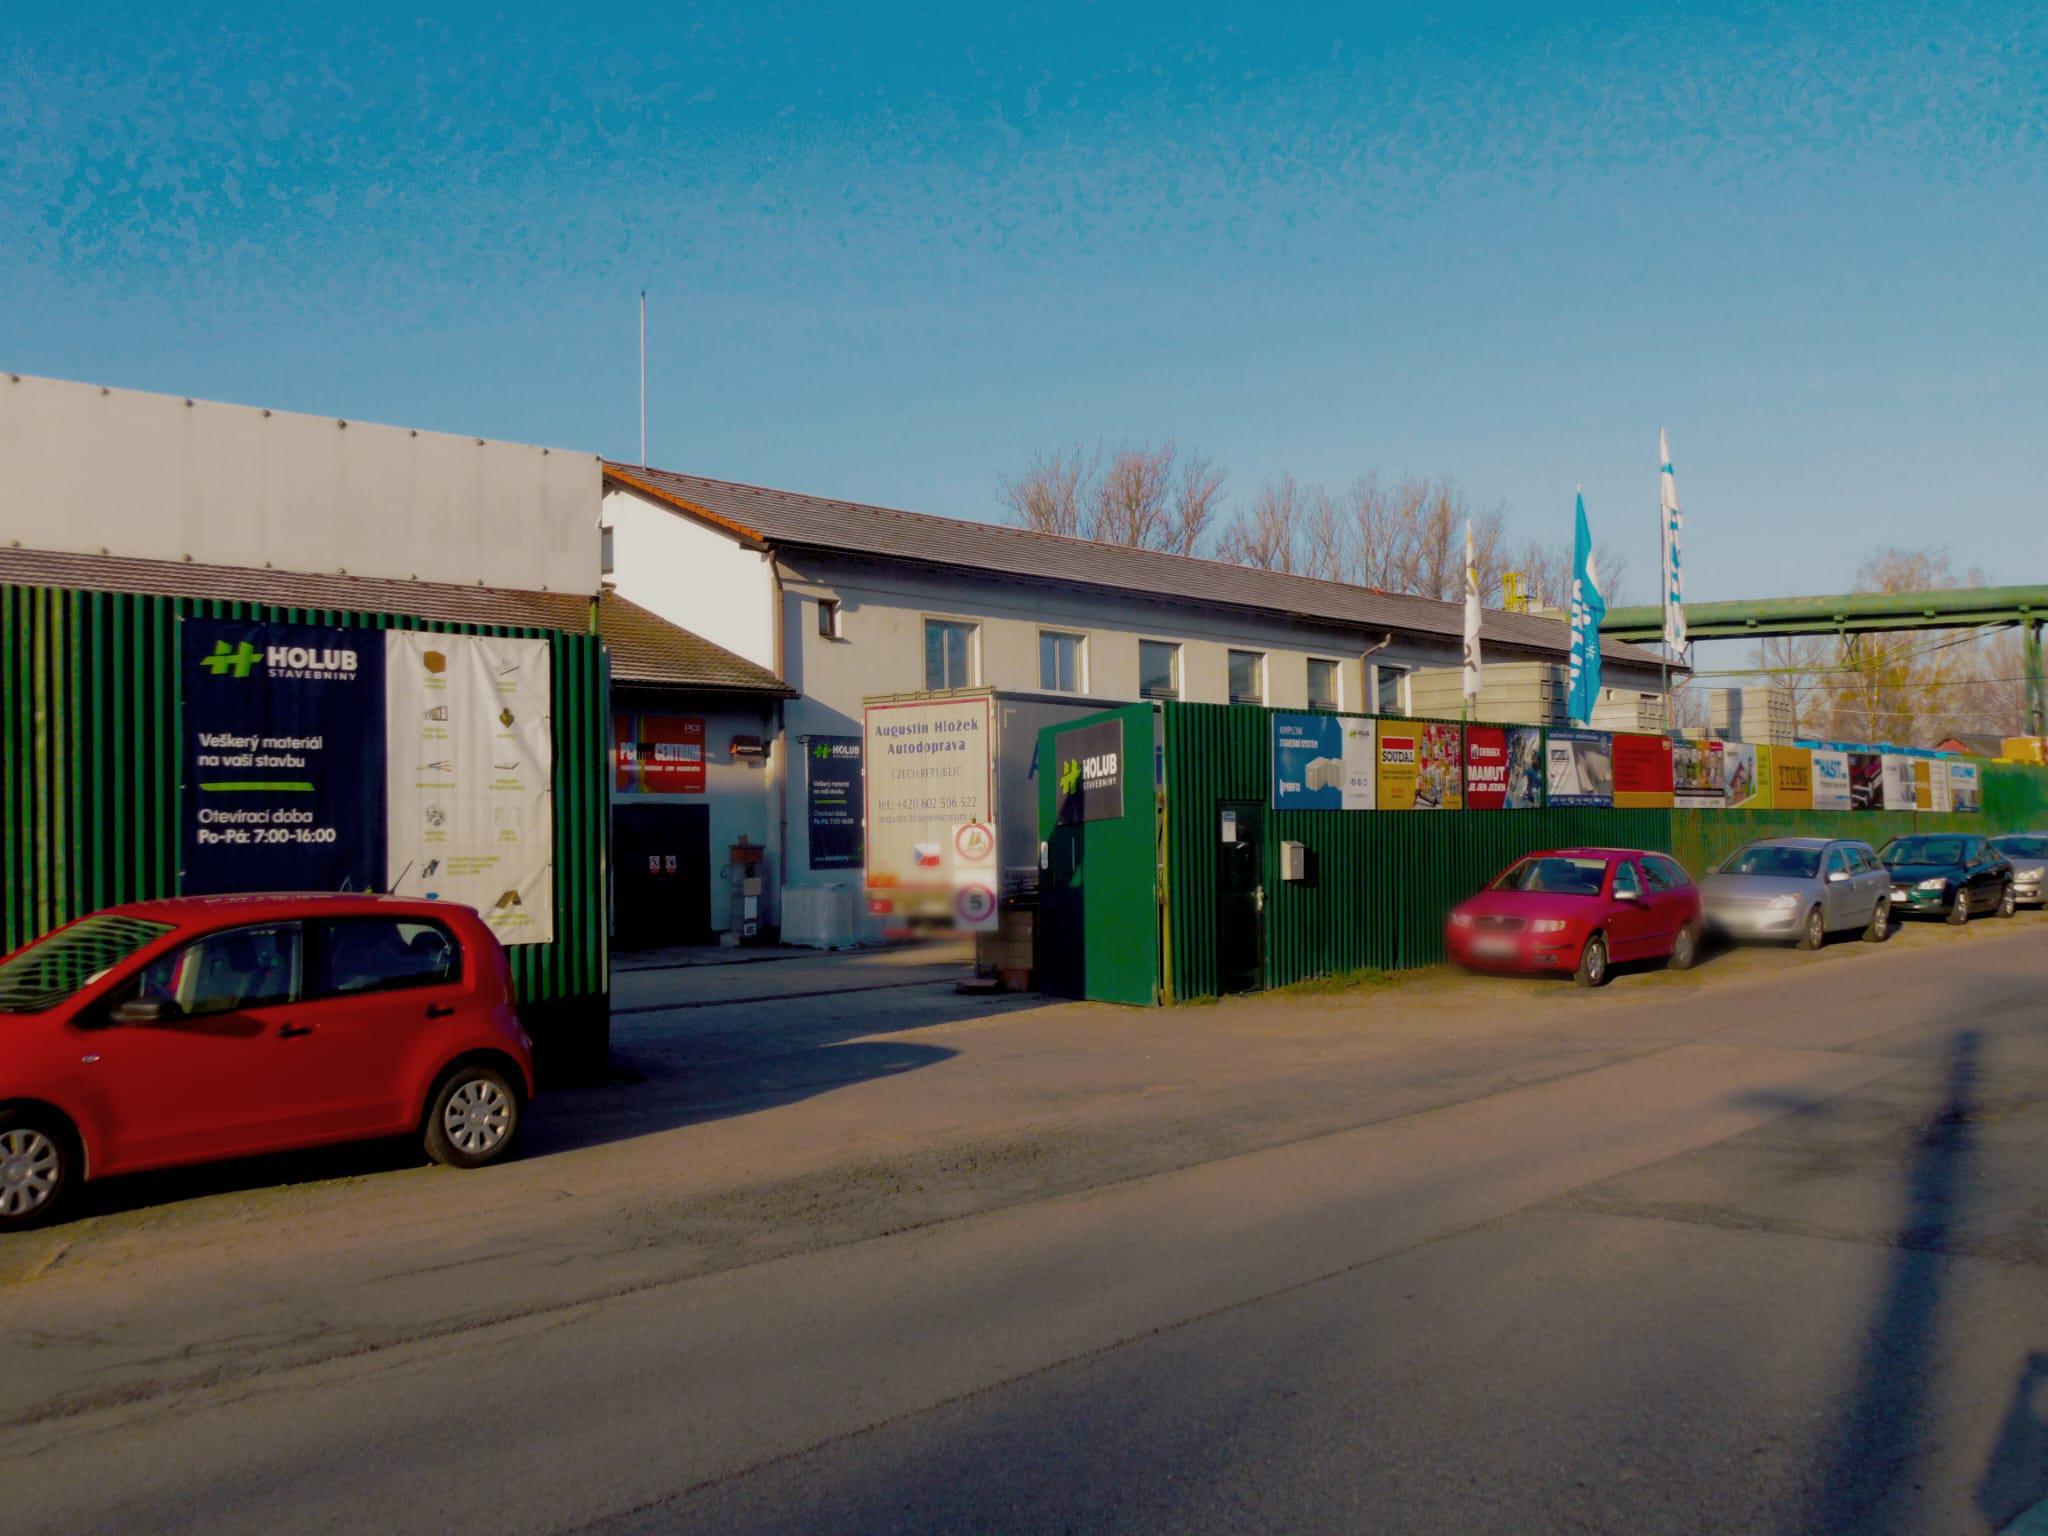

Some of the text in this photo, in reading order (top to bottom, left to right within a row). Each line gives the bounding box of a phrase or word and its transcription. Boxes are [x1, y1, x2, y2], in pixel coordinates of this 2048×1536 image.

[267, 646, 358, 670] HOLUB
[269, 669, 357, 680] STAVEBNINY
[875, 717, 979, 738] Augustin Hložek
[198, 733, 323, 752] Veškerý materiál
[832, 745, 861, 755] HOLUB
[887, 740, 966, 755] Autodoprava
[198, 754, 306, 768] na vaši stavbu
[1382, 750, 1415, 762] SOUDAL
[890, 766, 964, 780] CZECH REPUBLIC
[1082, 753, 1118, 780] HOLUB
[1467, 765, 1506, 781] MAMUT
[1778, 766, 1808, 786] YTONG
[960, 795, 977, 808] 522
[198, 808, 314, 824] Otevírací doba
[197, 828, 337, 845] Po-Pá: 7:00-16:00
[969, 893, 983, 911] 5
